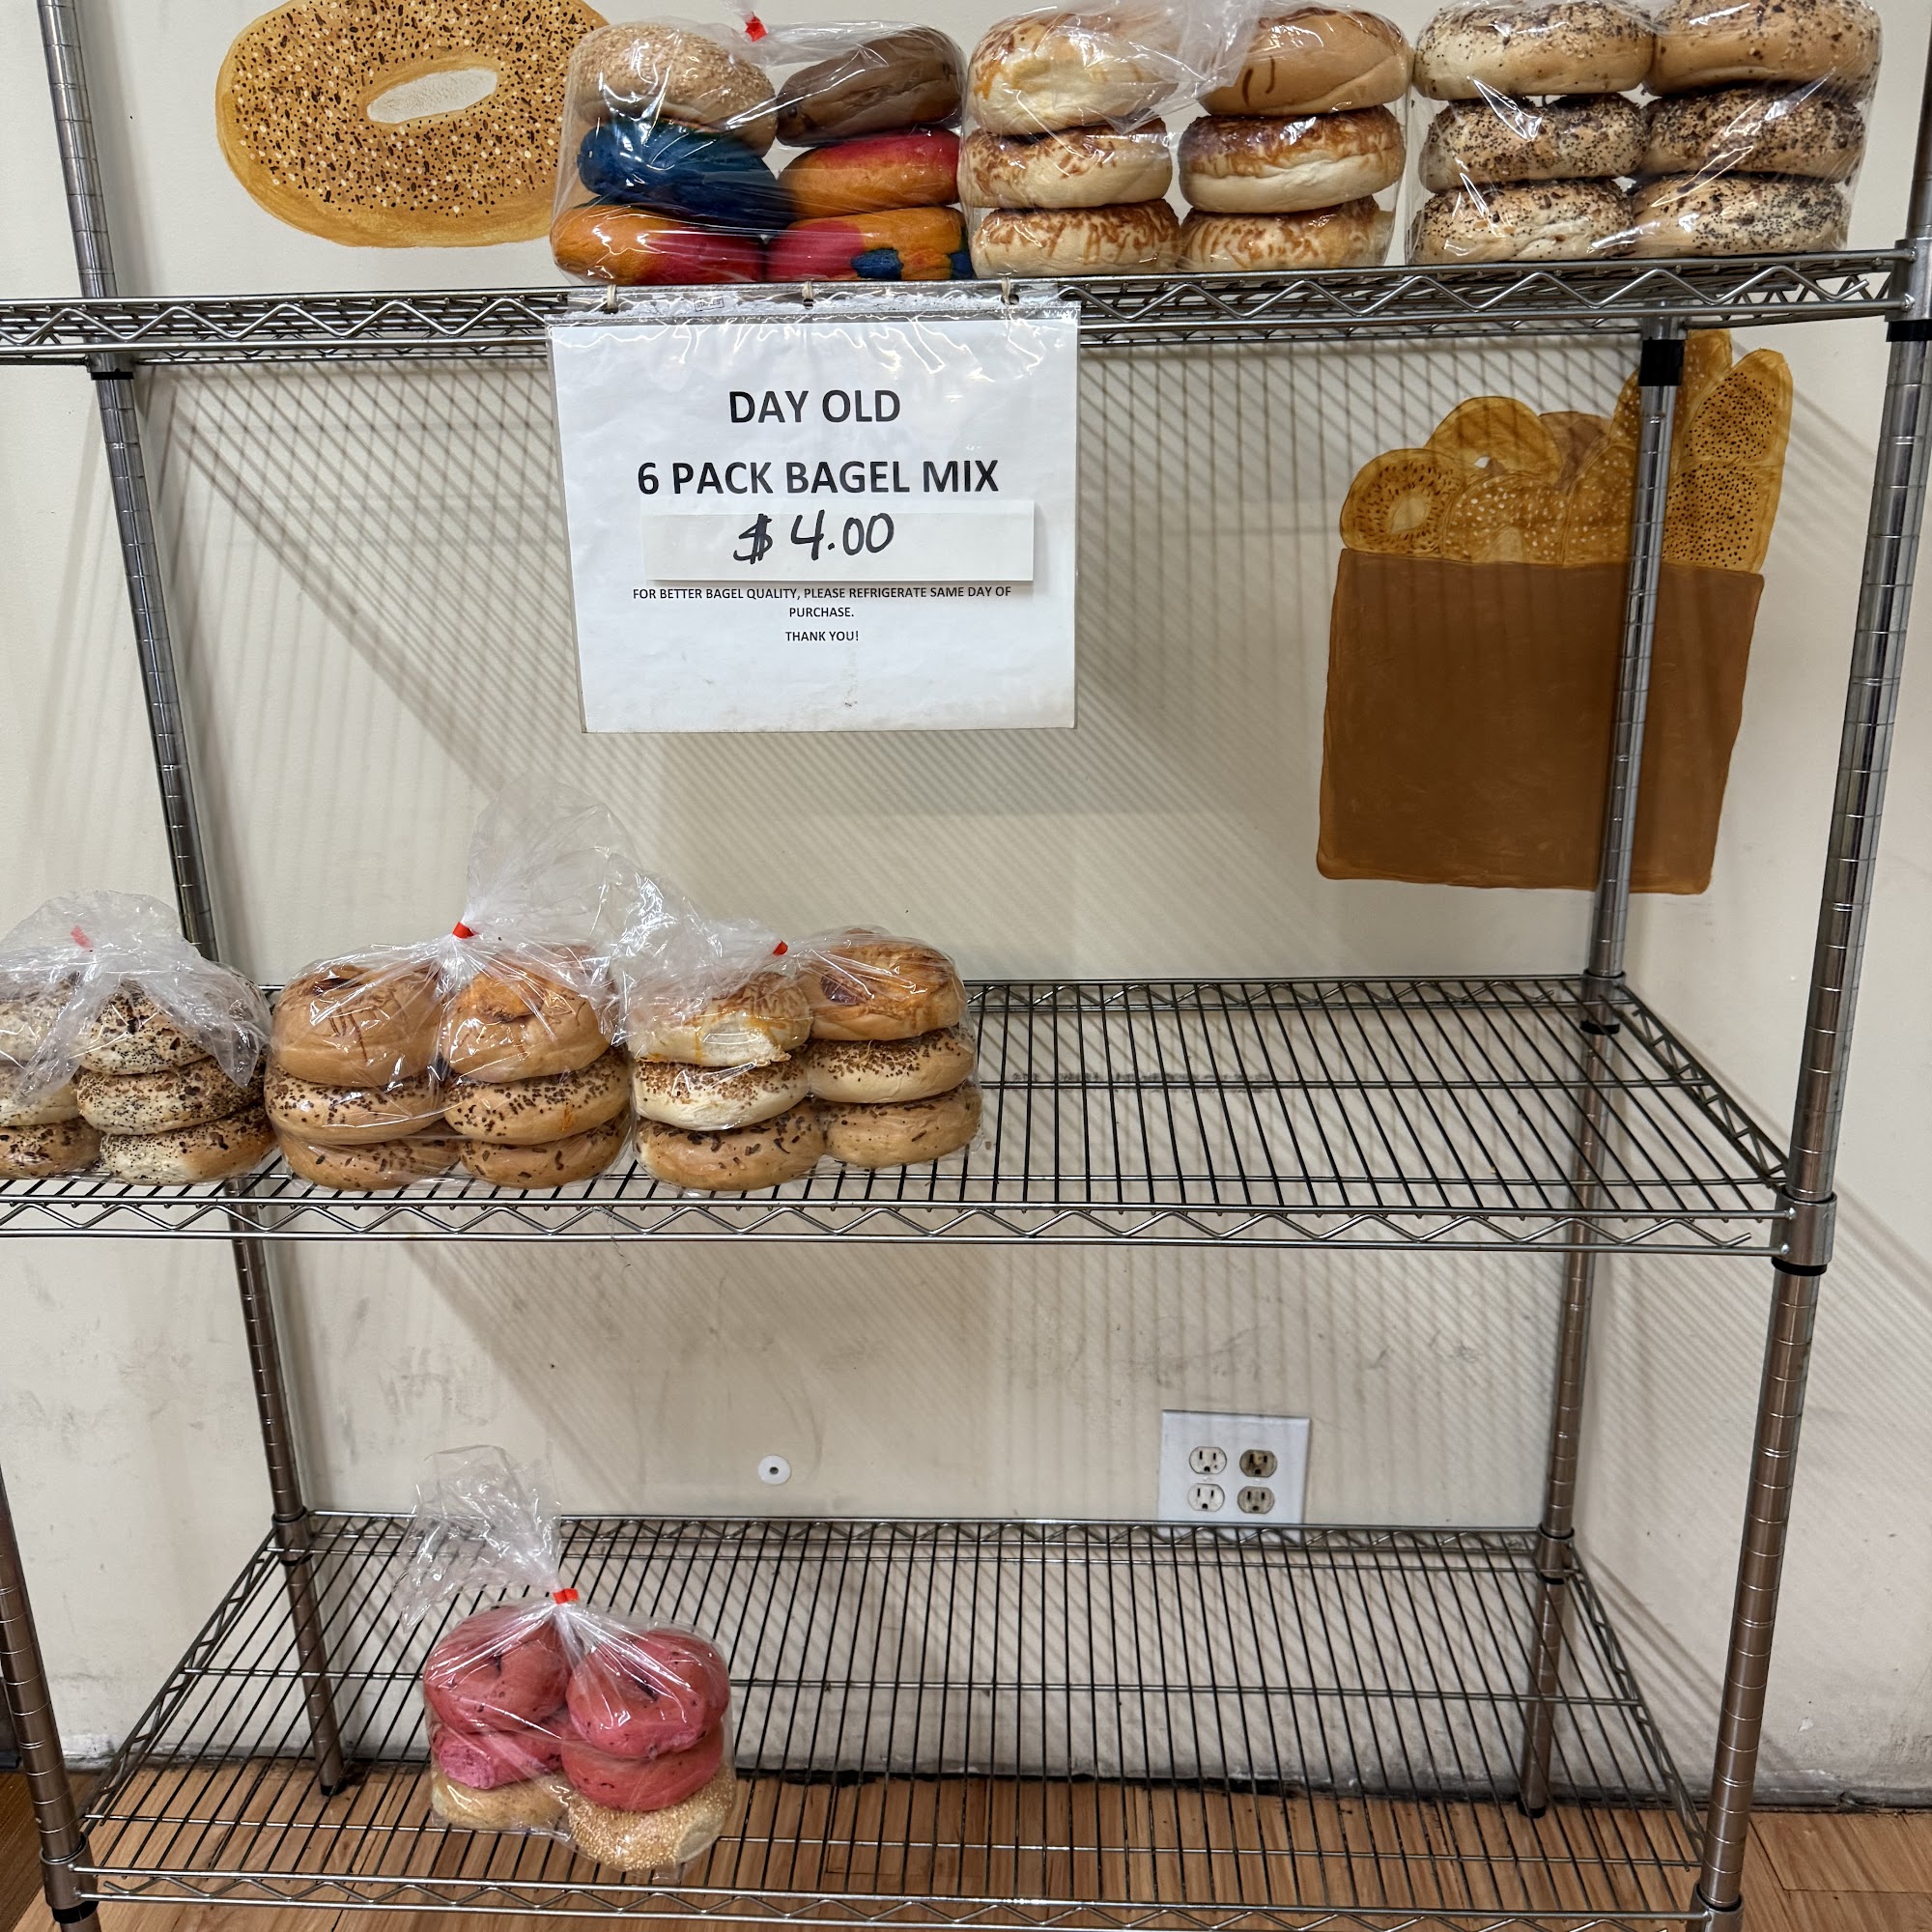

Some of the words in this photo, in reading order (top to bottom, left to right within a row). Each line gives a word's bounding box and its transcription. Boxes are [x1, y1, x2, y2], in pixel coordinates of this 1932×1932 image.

[728, 389, 809, 423] DAY
[821, 388, 900, 422] OLD
[638, 462, 659, 495] 6
[672, 461, 773, 494] PACK
[785, 460, 909, 493] BAGEL
[923, 459, 999, 492] MIX
[633, 588, 656, 599] FOR
[660, 588, 702, 599] BETTER
[705, 588, 744, 599] BAGEL
[746, 587, 801, 600] QUALITY,
[804, 587, 845, 598] PLEASE
[849, 586, 927, 598] REFRIGERATE
[929, 586, 965, 597] SAME
[968, 586, 993, 597] DAY
[995, 585, 1011, 597] OF
[789, 607, 855, 617] PURCHASE.
[784, 631, 826, 641] THANK
[828, 630, 859, 641] YOU!
